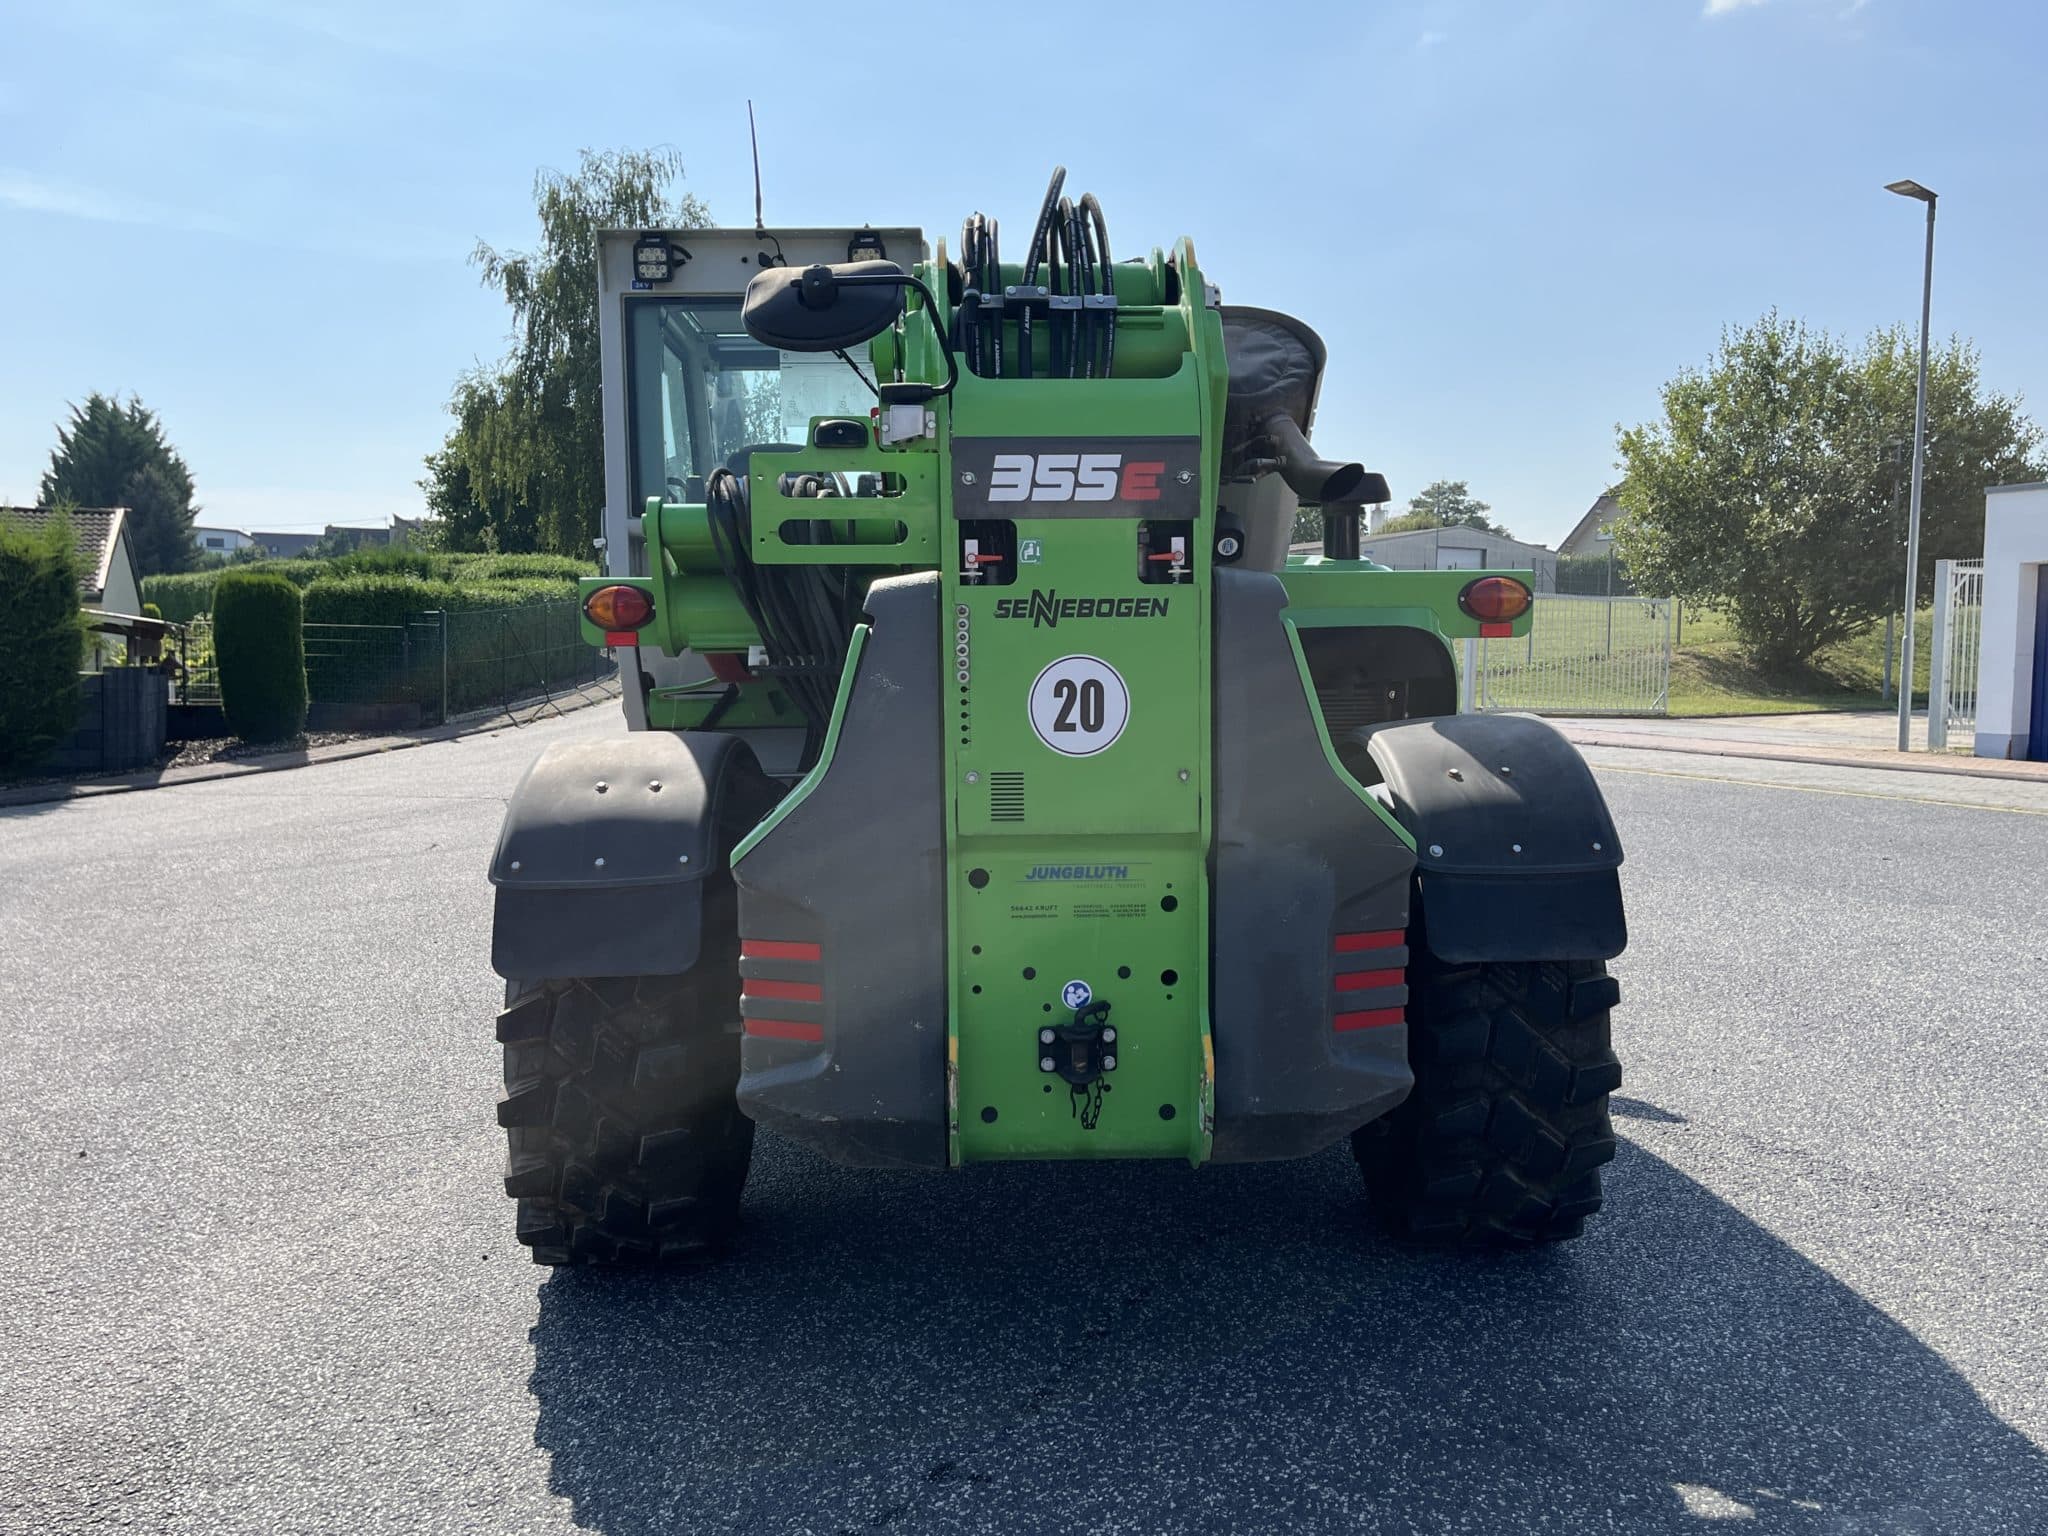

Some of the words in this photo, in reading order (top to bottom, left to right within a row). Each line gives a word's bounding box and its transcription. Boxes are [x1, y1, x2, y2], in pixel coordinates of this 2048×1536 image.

[995, 589, 1169, 628] SENNEBOGEN
[1053, 678, 1105, 733] 20
[1025, 865, 1128, 880] JUNGBLUTH
